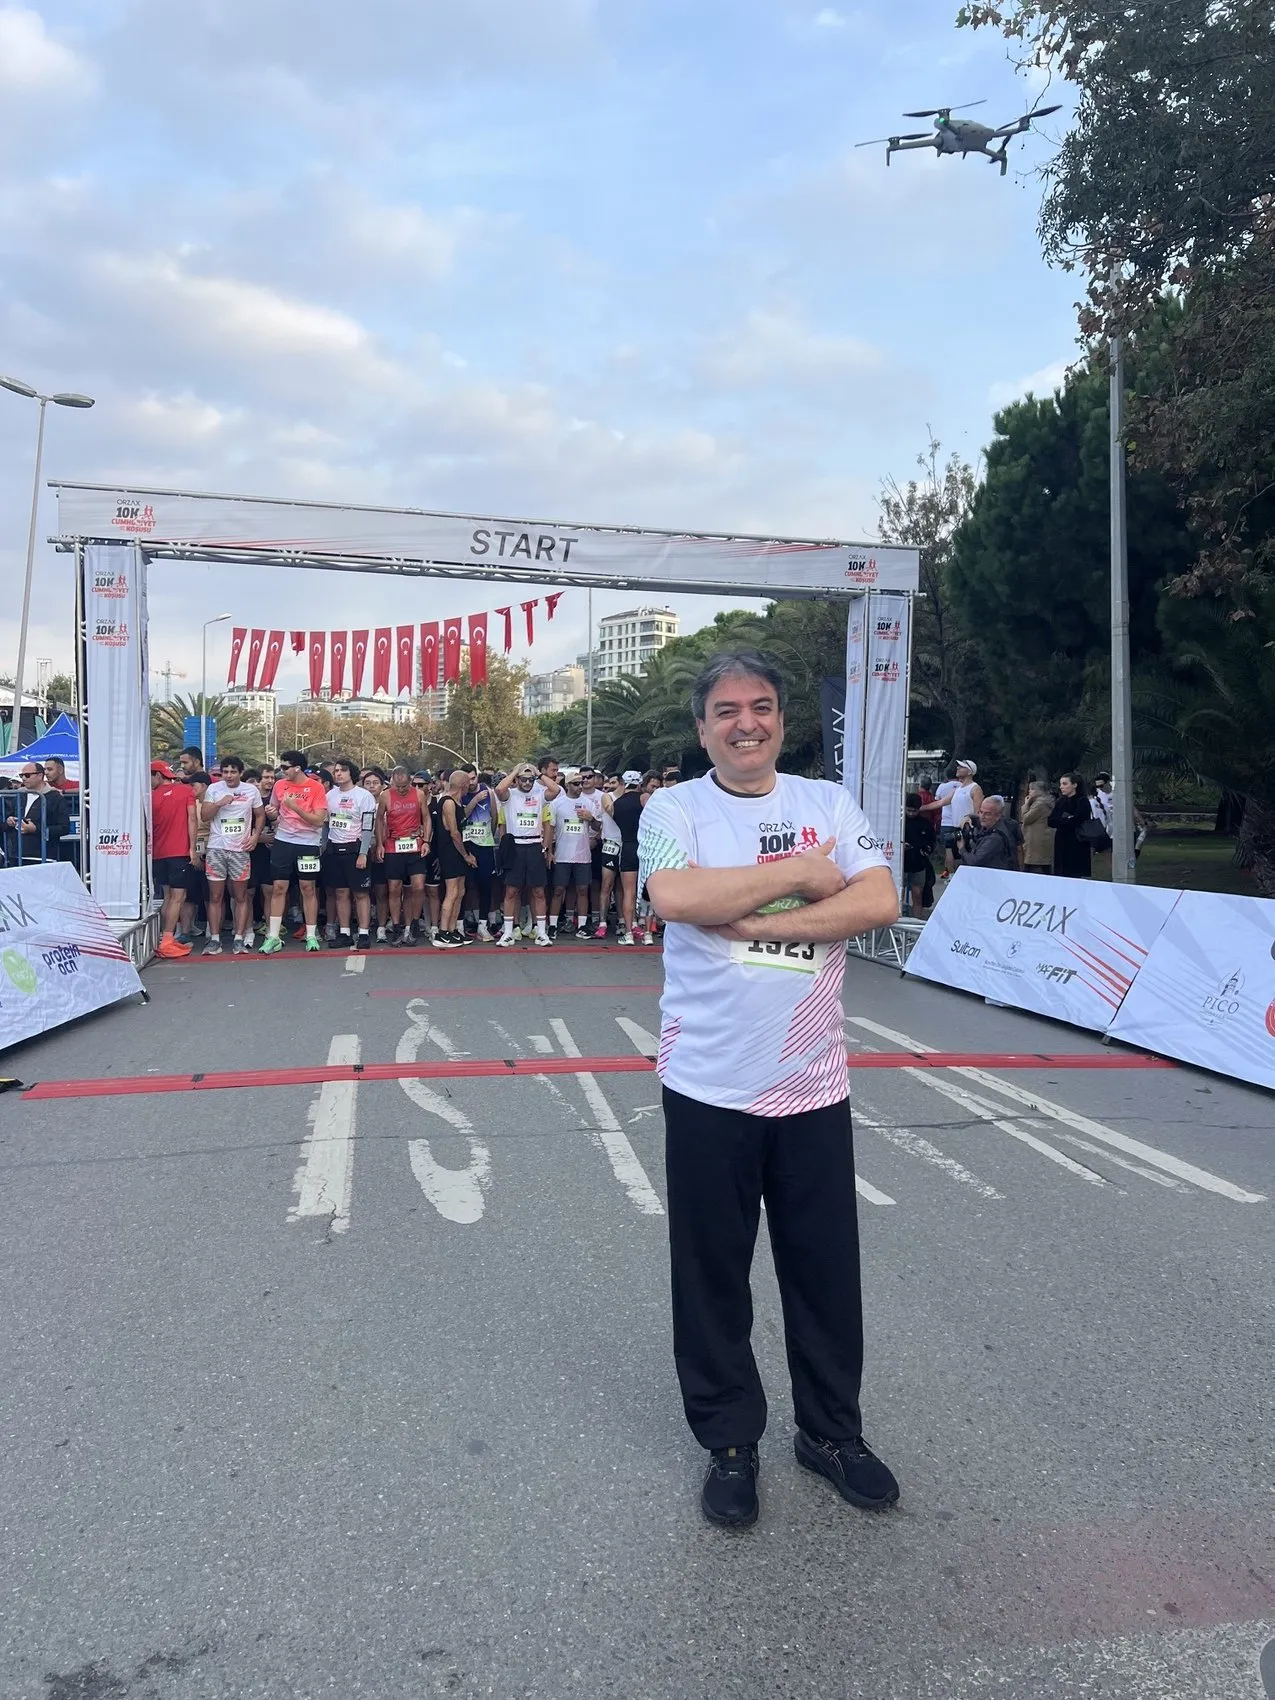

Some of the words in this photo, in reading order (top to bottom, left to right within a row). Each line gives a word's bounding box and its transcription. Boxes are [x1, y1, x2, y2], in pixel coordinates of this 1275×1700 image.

[116, 507, 140, 519] 10K
[470, 529, 579, 562] START
[848, 561, 866, 571] 10K
[95, 578, 115, 587] 10K
[96, 625, 116, 635] 10K
[877, 622, 893, 630] 10K
[875, 664, 891, 672] 10K
[224, 825, 242, 833] 2623
[758, 820, 797, 833] ORZAX
[99, 835, 119, 844] 10K
[760, 832, 796, 854] 10K
[300, 863, 318, 871] 1982
[996, 898, 1078, 935] ORZAX
[950, 940, 982, 958] Sultan
[42, 943, 81, 970] protein
[1202, 996, 1240, 1015] PICO
